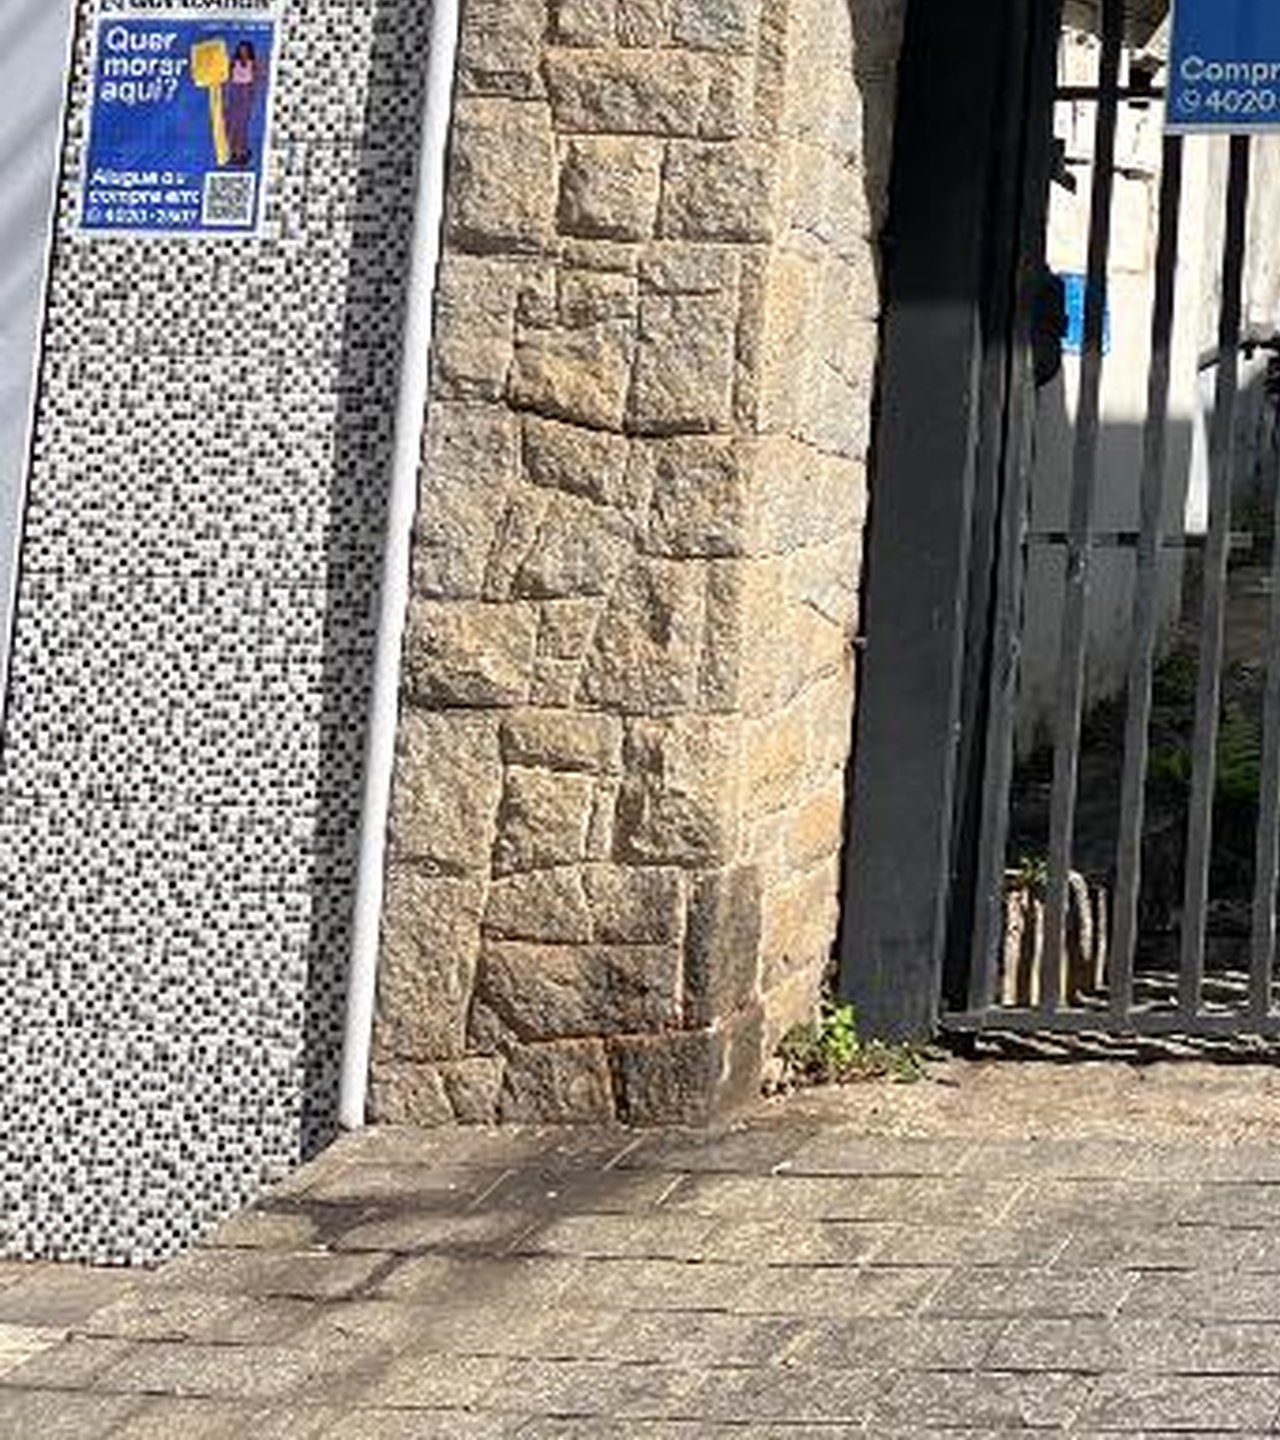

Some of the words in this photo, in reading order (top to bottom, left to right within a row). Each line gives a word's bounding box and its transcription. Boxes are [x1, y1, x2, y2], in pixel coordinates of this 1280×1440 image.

[106, 25, 178, 54] Quer
[103, 59, 188, 77] morar
[100, 78, 179, 106] aqui?
